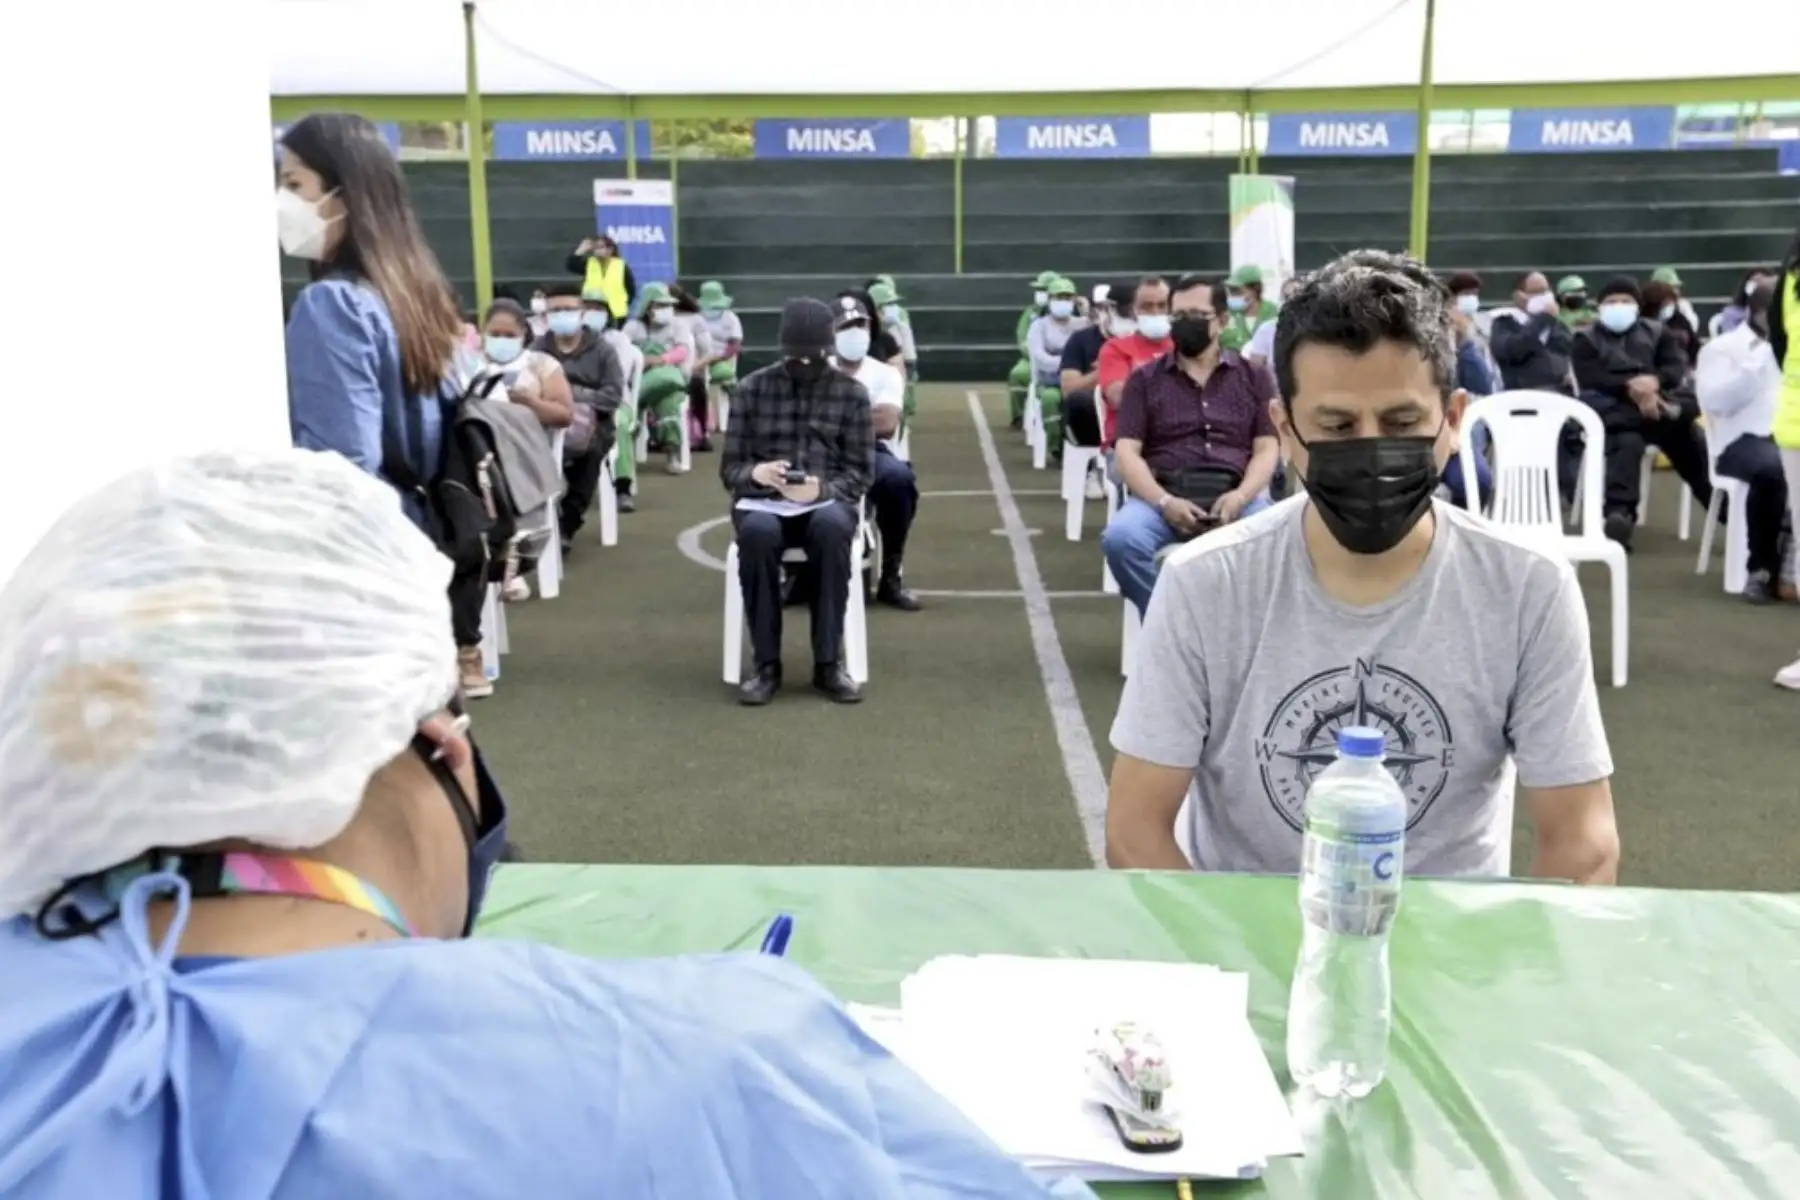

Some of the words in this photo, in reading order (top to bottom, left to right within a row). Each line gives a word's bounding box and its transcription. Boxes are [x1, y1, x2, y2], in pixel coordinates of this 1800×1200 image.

[526, 130, 617, 154] MINSA
[787, 128, 877, 153] MINSA
[1027, 123, 1118, 150] MINSA
[1299, 122, 1390, 149] MINSA
[1540, 119, 1634, 147] MINSA
[606, 225, 666, 244] MINSA
[1354, 655, 1377, 679] N
[1255, 739, 1278, 762] W
[1442, 747, 1455, 768] E
